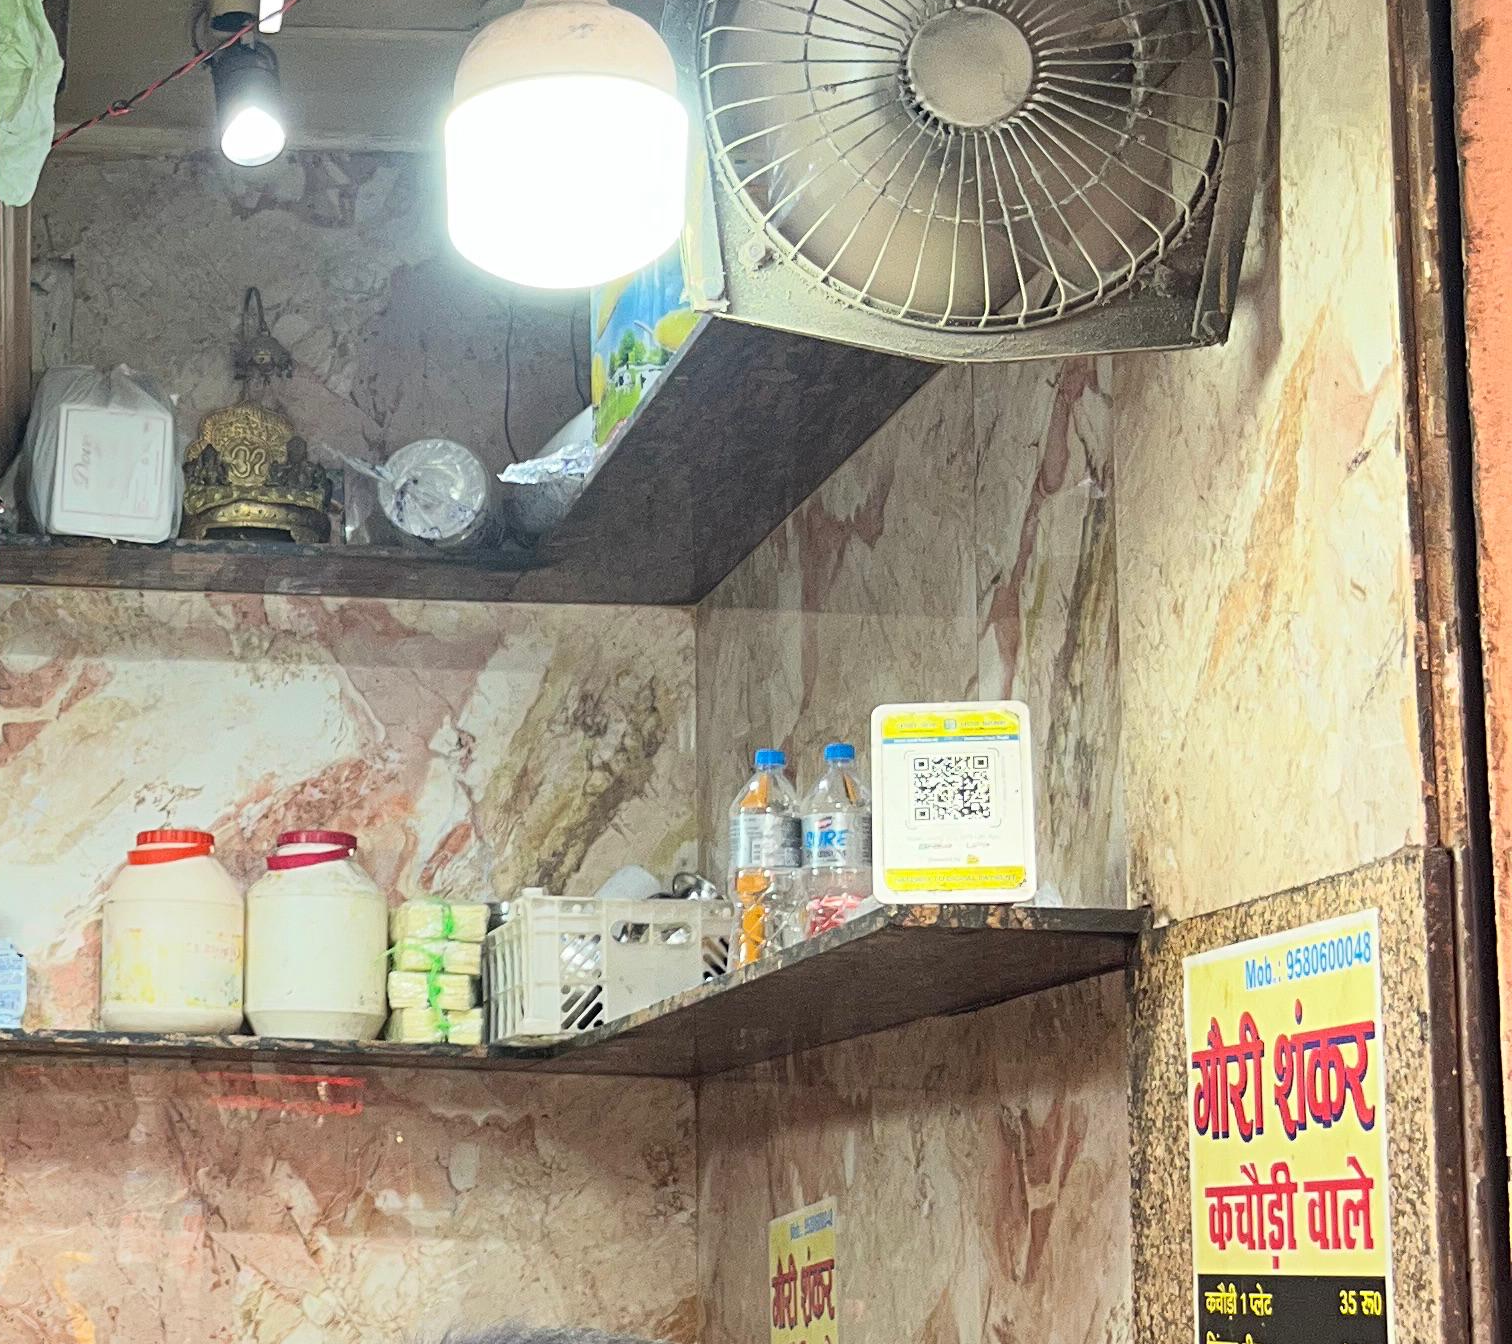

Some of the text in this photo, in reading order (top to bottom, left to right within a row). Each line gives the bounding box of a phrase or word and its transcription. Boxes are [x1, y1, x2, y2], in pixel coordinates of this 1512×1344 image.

[1191, 998, 1377, 1143] गौरी शंकर
[1204, 1155, 1375, 1270] कचौड़ी वाले
[1339, 1290, 1358, 1314] 35
